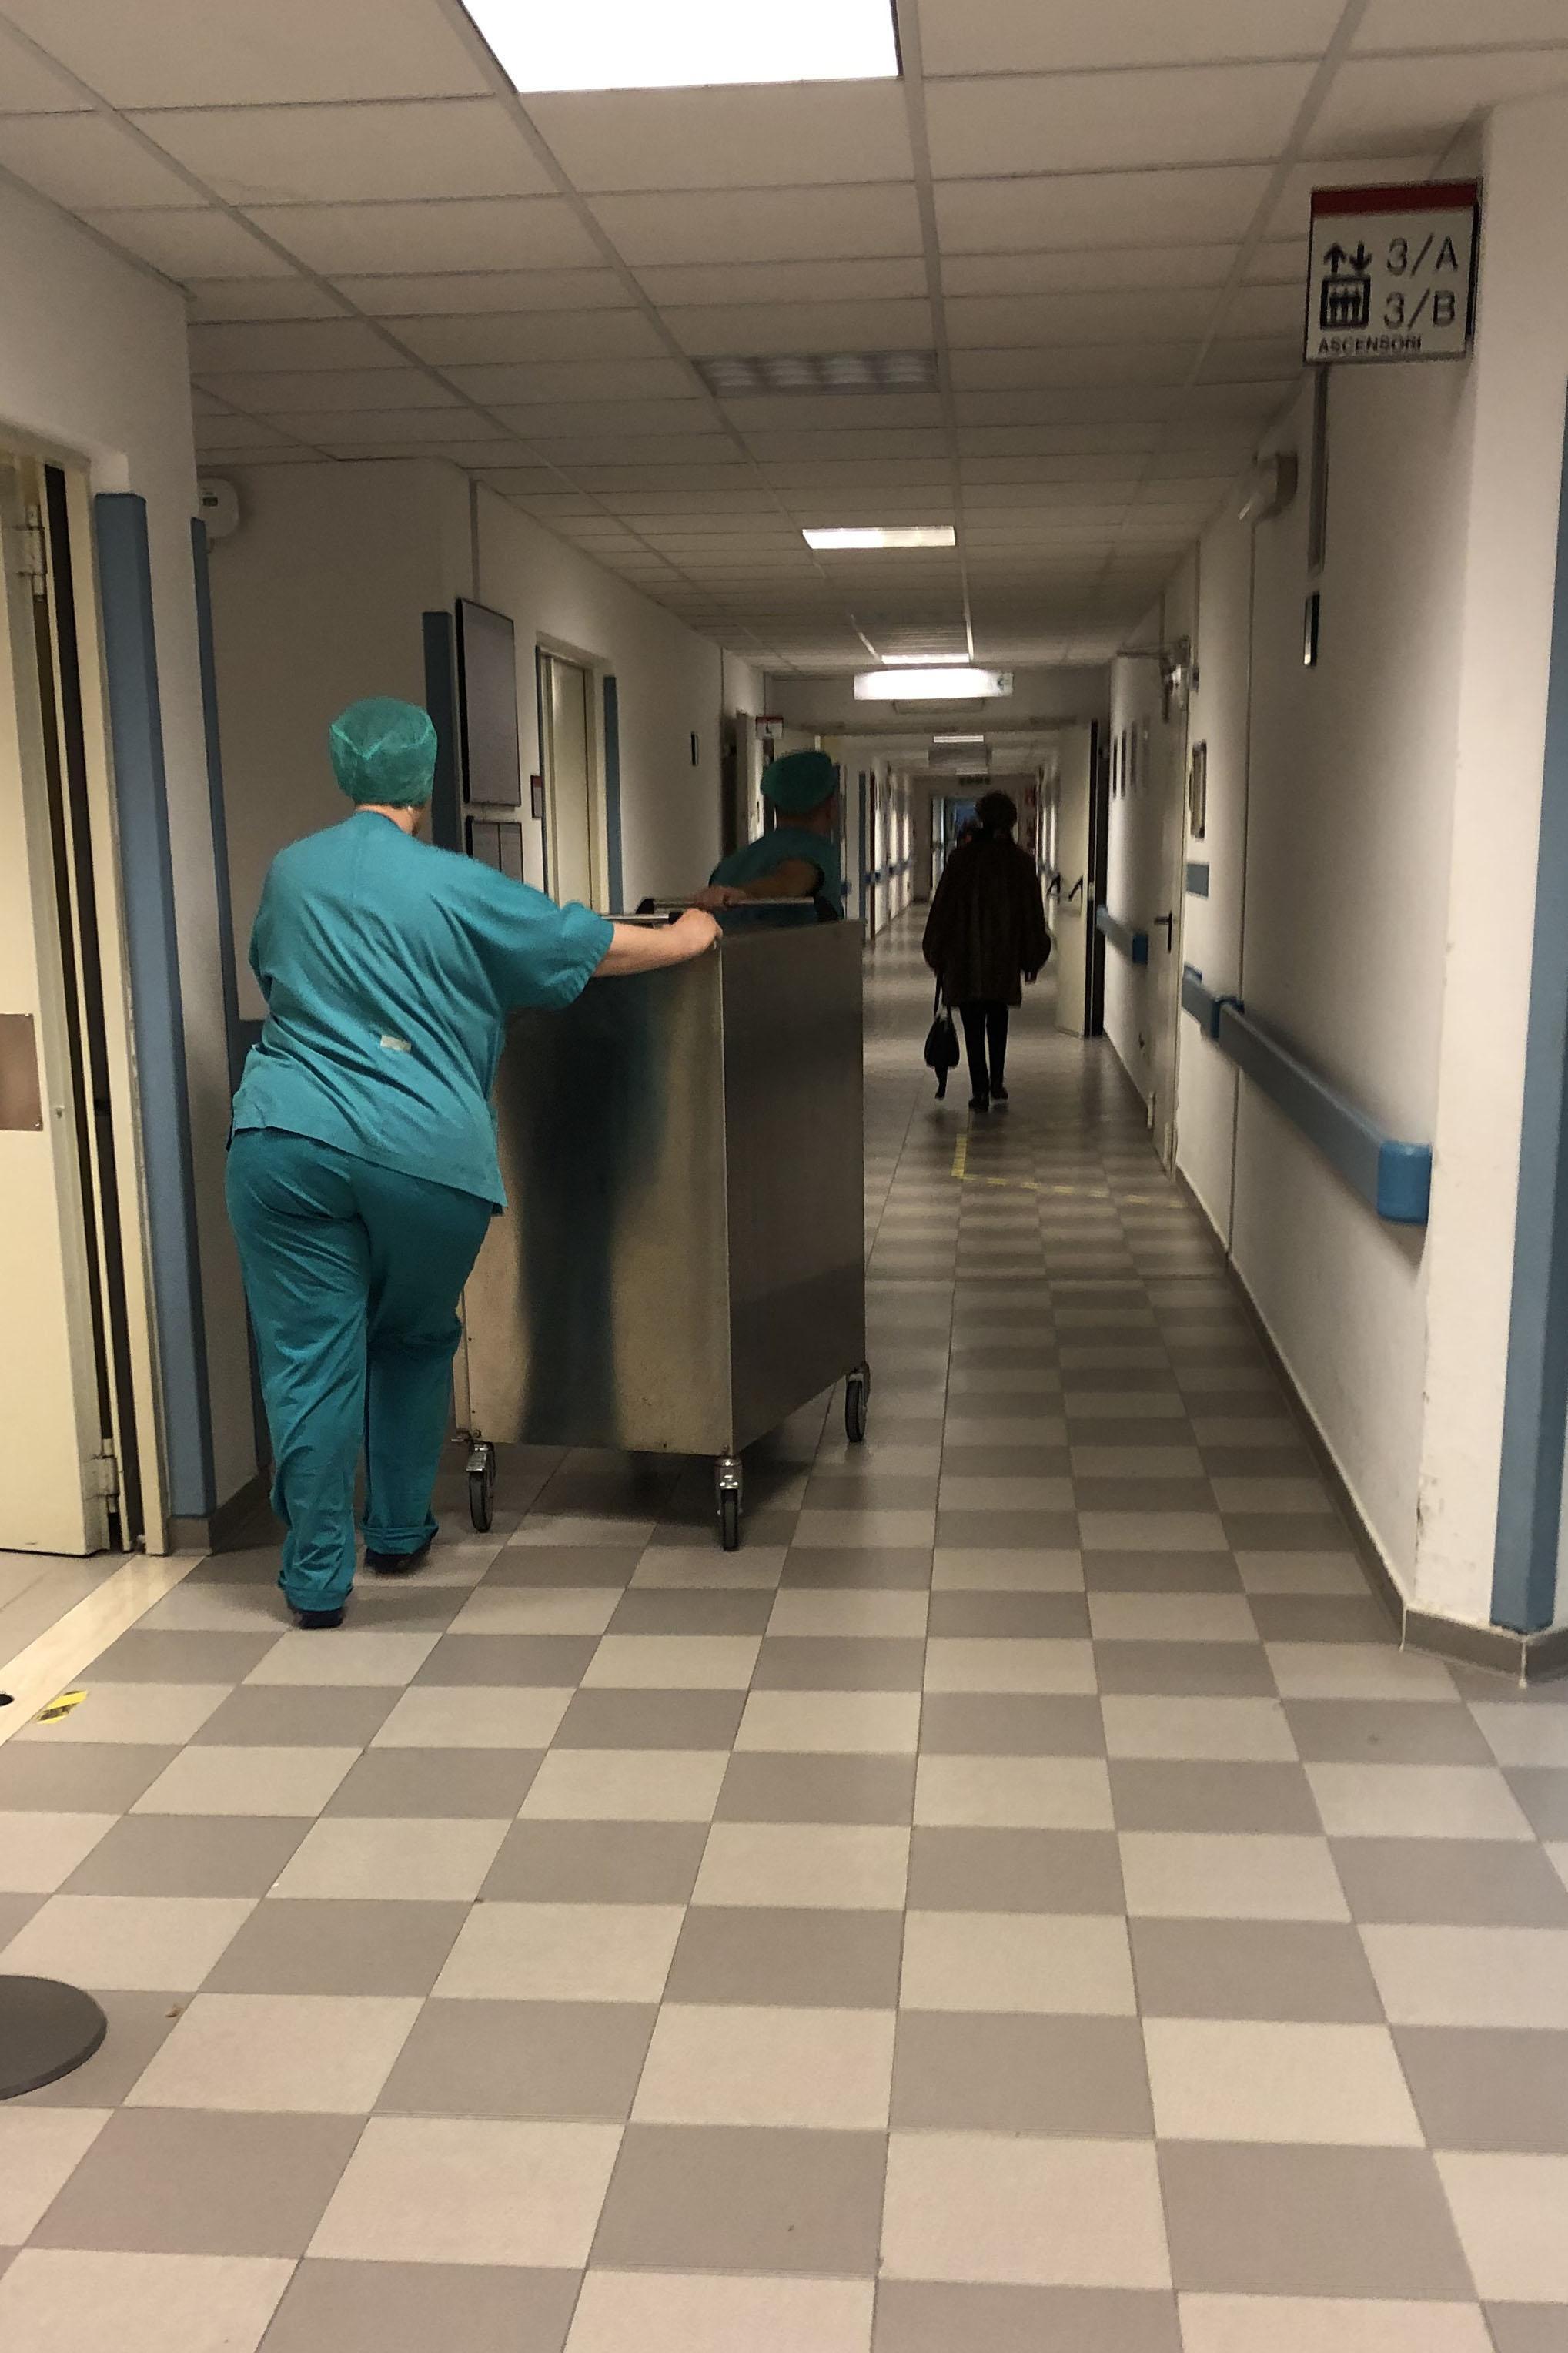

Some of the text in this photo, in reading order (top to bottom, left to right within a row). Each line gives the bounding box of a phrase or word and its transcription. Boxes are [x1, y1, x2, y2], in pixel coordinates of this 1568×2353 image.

[1386, 233, 1458, 278] 3/A
[1384, 288, 1455, 330] 3/B
[1318, 334, 1423, 354] ASCENSORI
